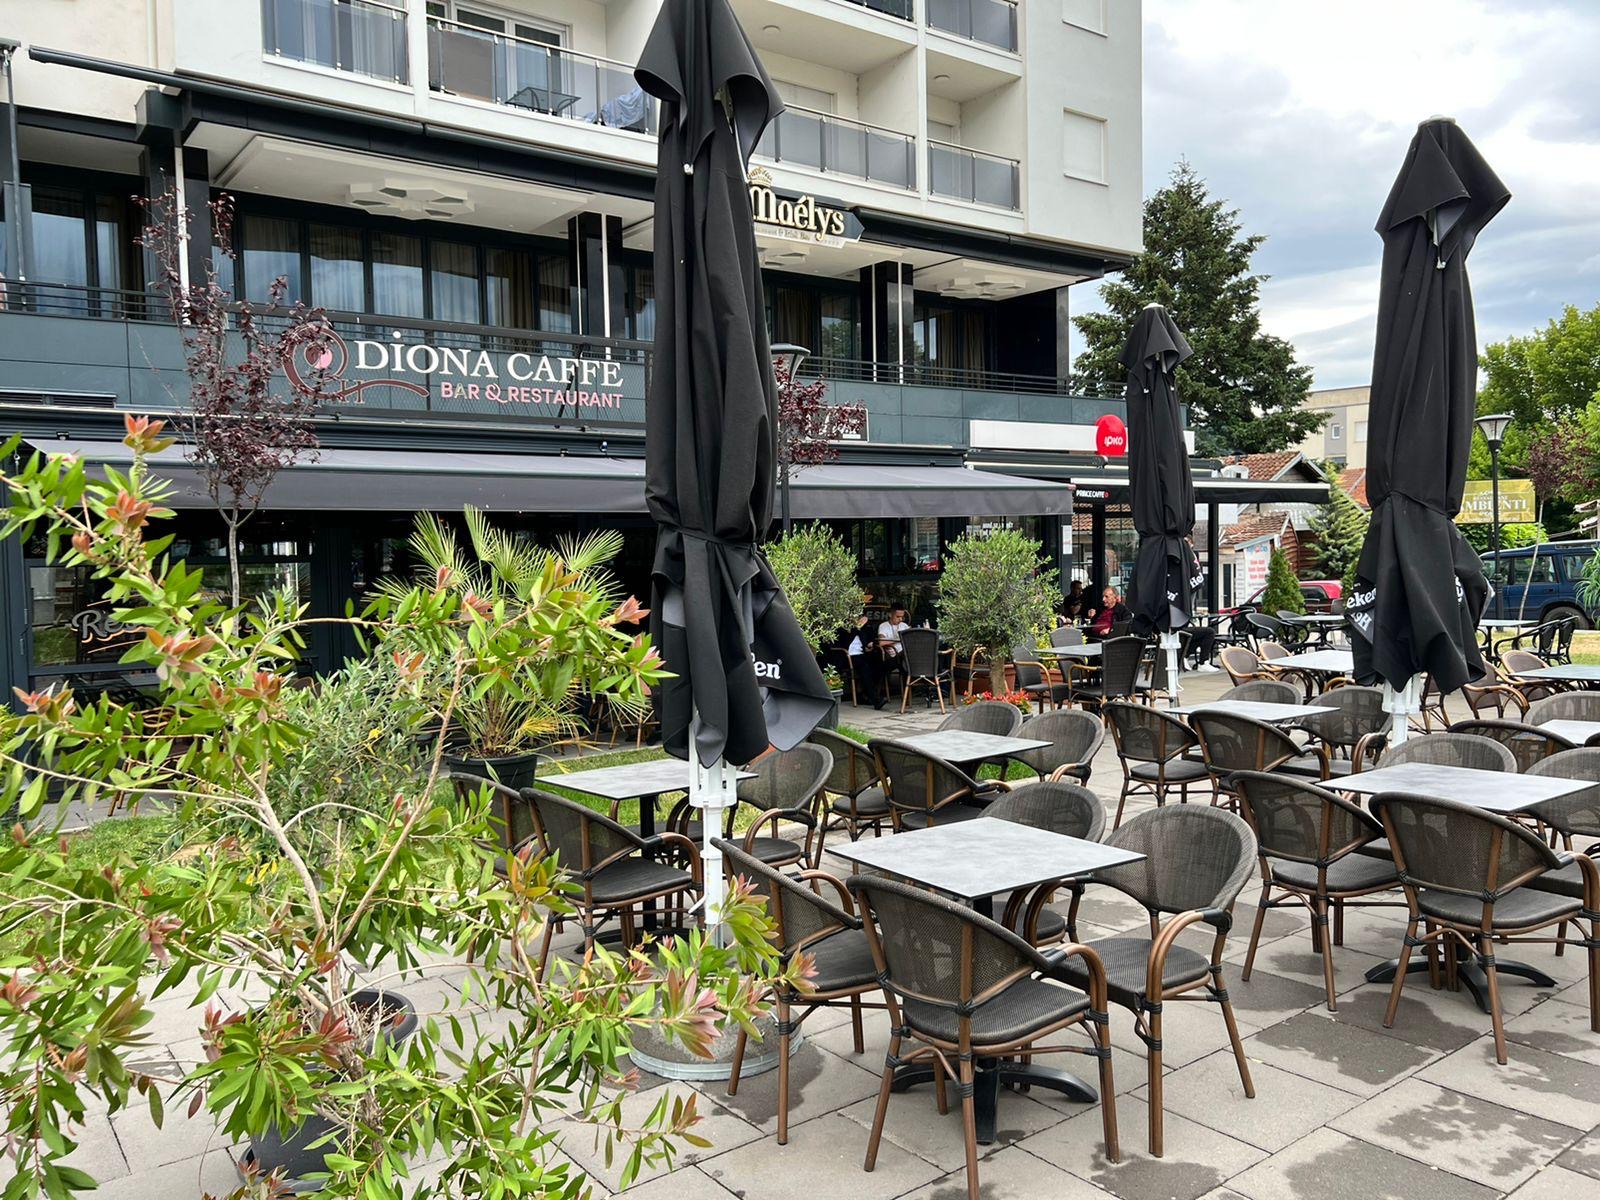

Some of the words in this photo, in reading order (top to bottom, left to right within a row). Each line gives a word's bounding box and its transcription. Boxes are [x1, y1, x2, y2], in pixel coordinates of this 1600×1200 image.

[507, 353, 624, 387] CAFFE
[441, 381, 480, 400] BAR
[485, 383, 508, 404] &
[508, 386, 623, 408] RESTAURANT
[1461, 499, 1528, 512] MBINTI
